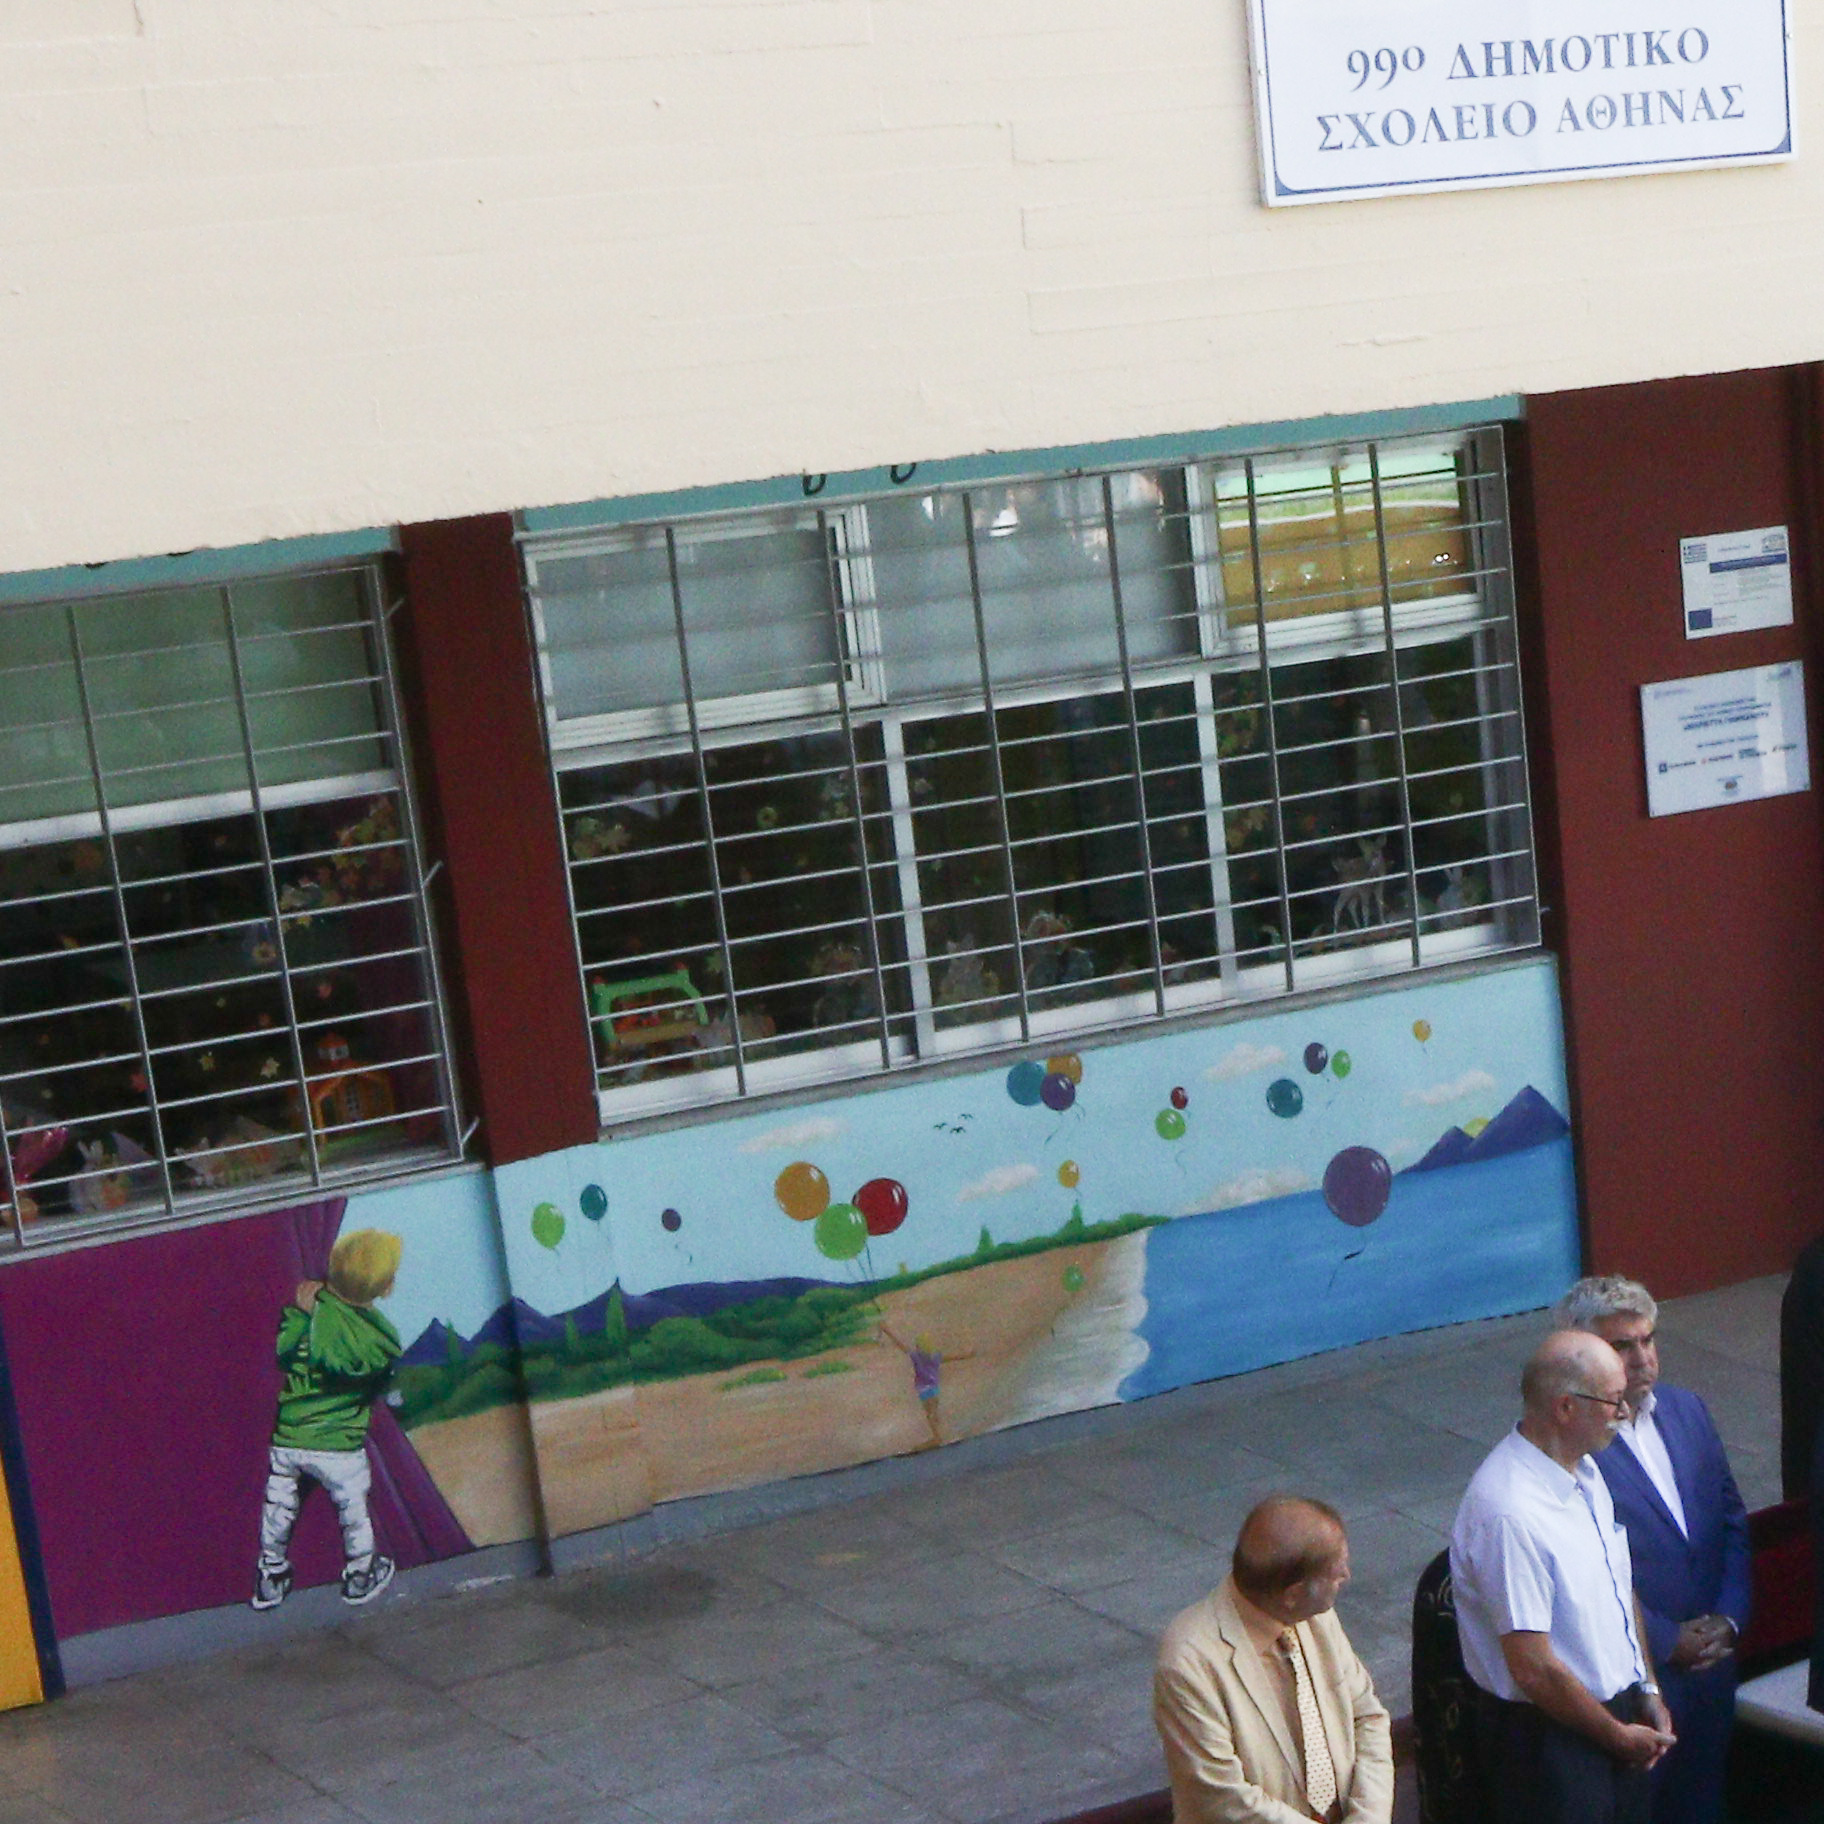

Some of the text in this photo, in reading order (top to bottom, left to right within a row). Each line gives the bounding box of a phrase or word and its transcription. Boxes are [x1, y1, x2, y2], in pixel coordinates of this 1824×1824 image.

[1447, 26, 1710, 80] ΔΗΜΟΤΙΚΟ
[1316, 84, 1746, 152] ΣΧΟΛΕΙΟ ΑΘΗΝΑΣ
